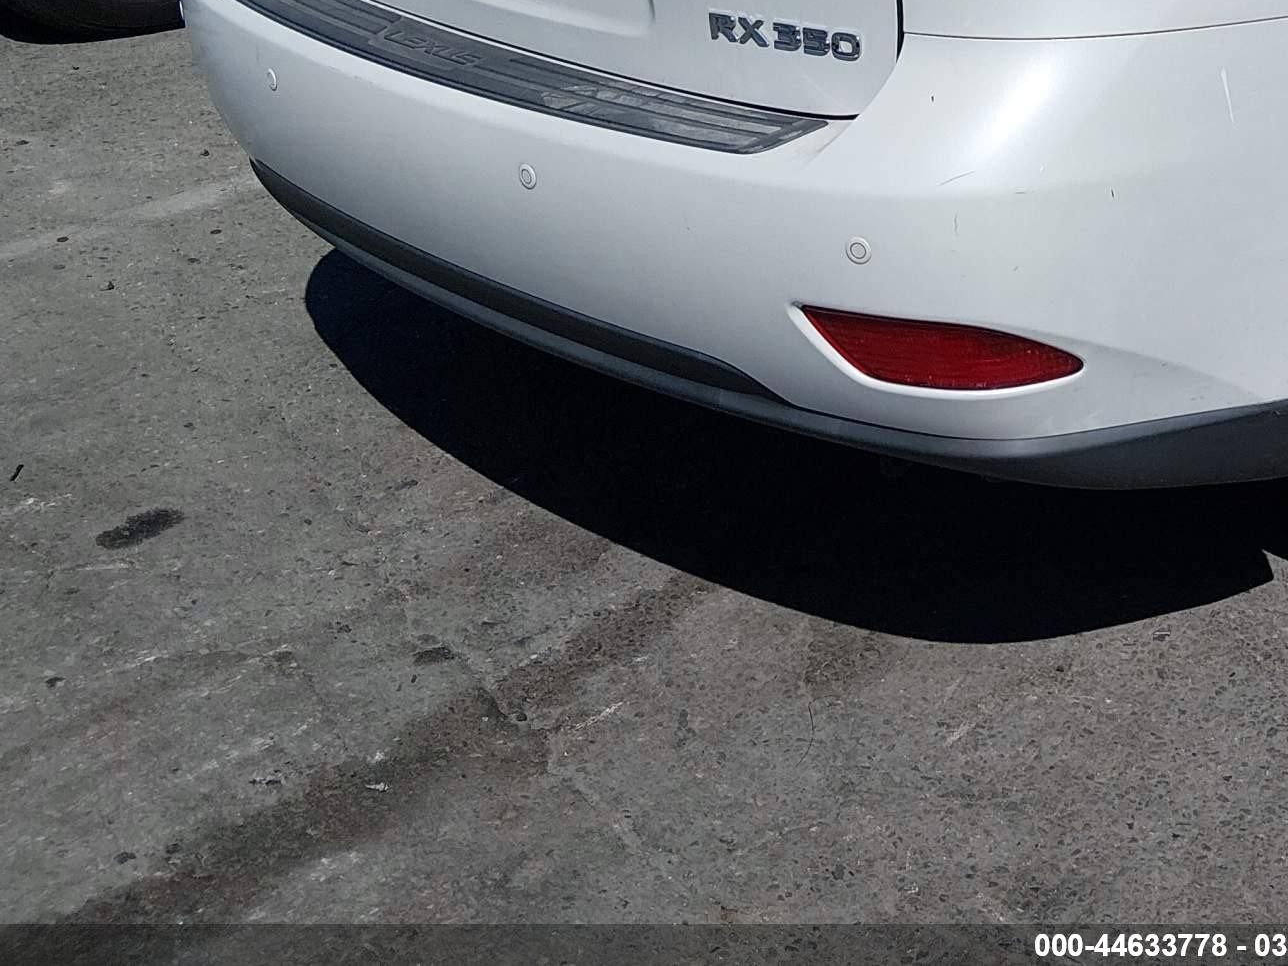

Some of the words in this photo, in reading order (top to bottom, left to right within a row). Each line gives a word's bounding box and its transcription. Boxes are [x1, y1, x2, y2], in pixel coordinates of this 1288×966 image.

[383, 30, 486, 66] LEXUS
[708, 11, 770, 48] RX
[772, 21, 861, 62] 350
